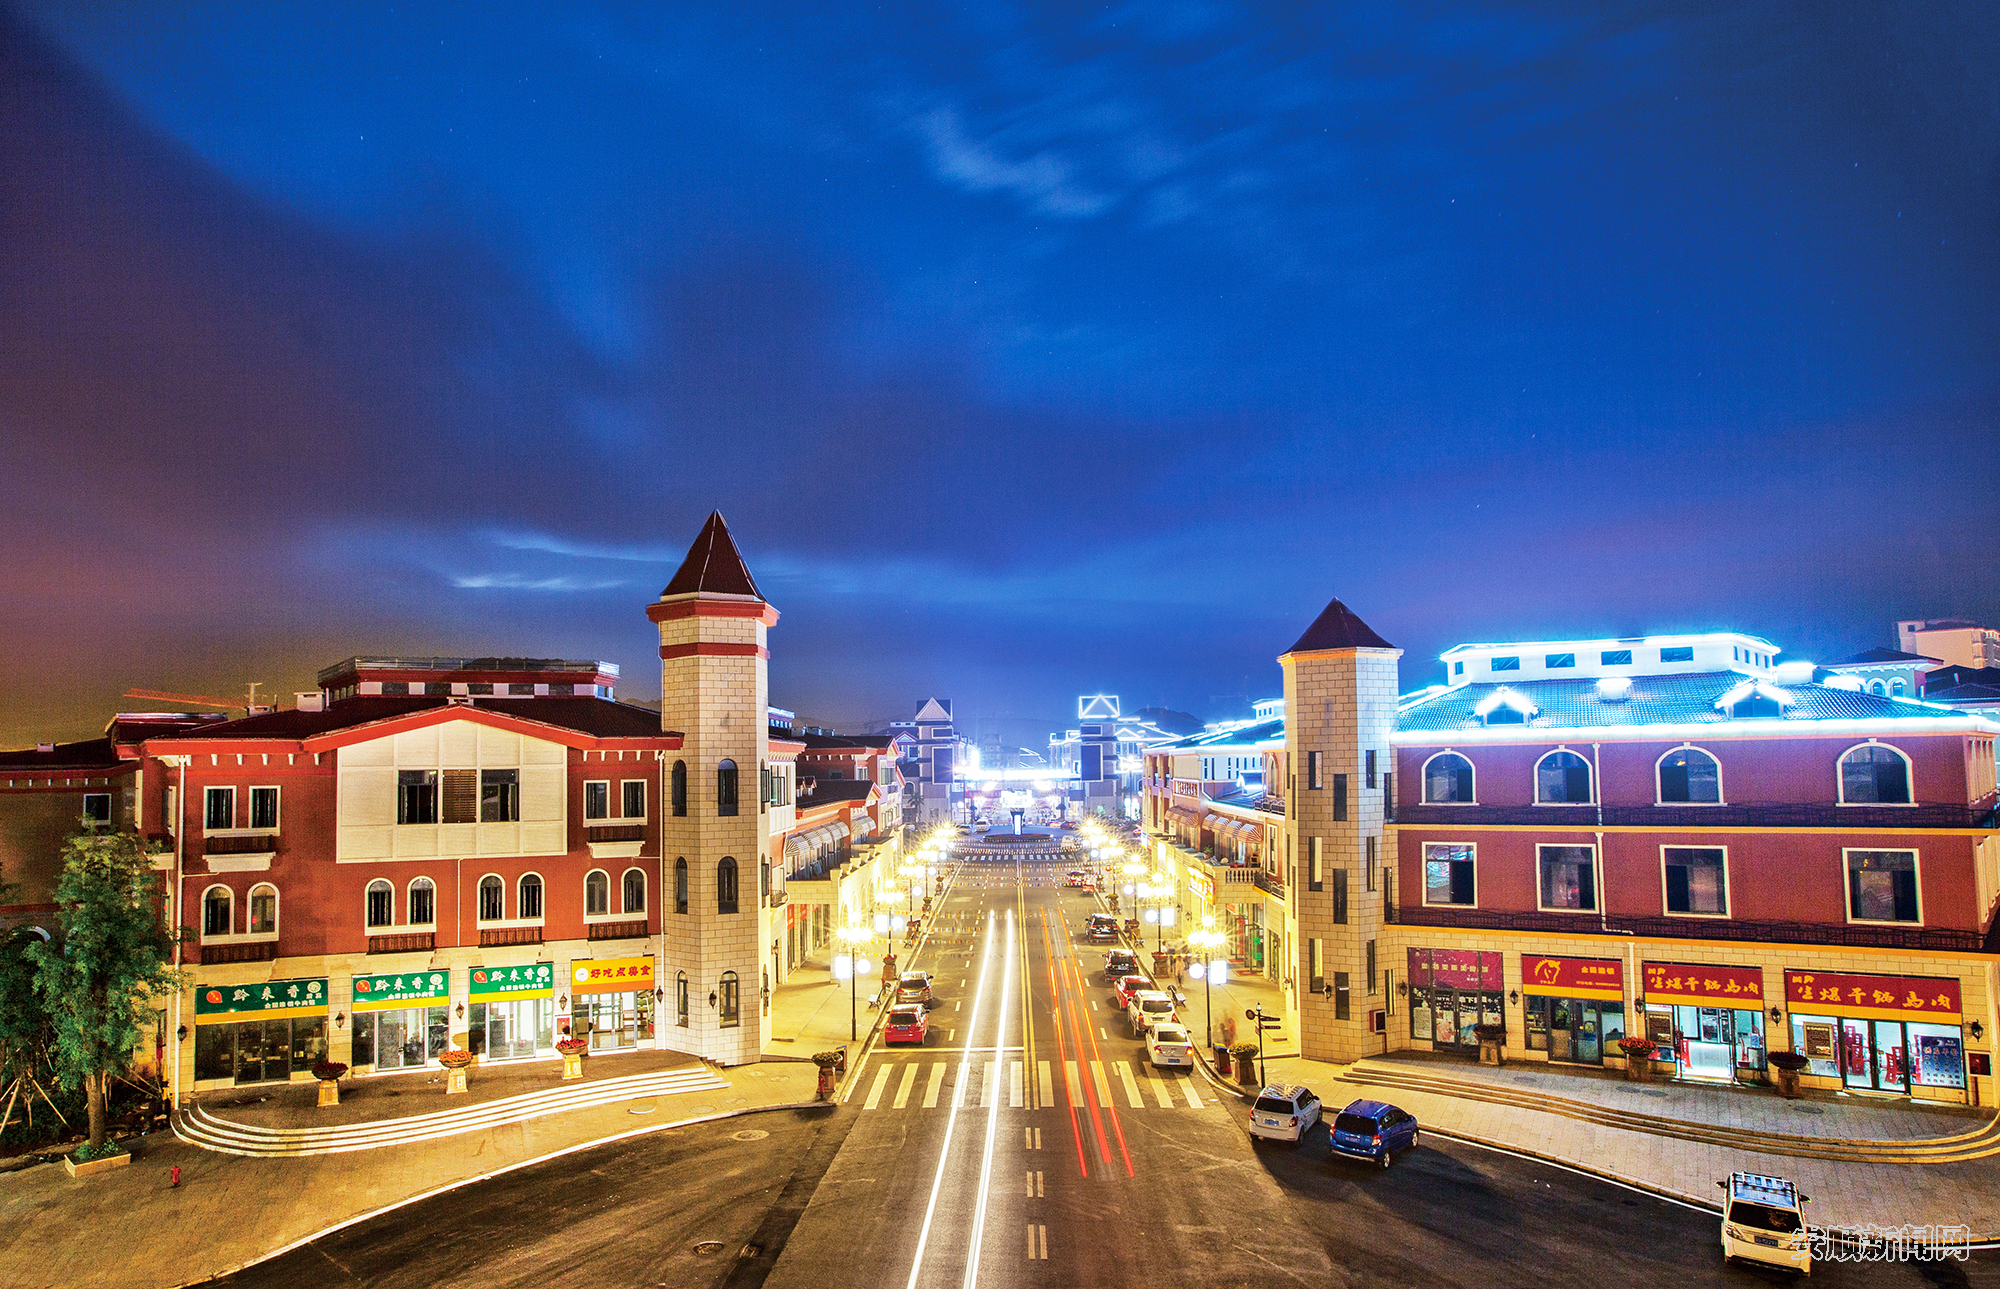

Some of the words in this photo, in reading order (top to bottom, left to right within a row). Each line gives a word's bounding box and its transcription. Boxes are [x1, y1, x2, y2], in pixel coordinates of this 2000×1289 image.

[490, 967, 535, 982] 黔来香
[374, 976, 424, 992] 黔来香
[232, 984, 300, 1002] 黔来香
